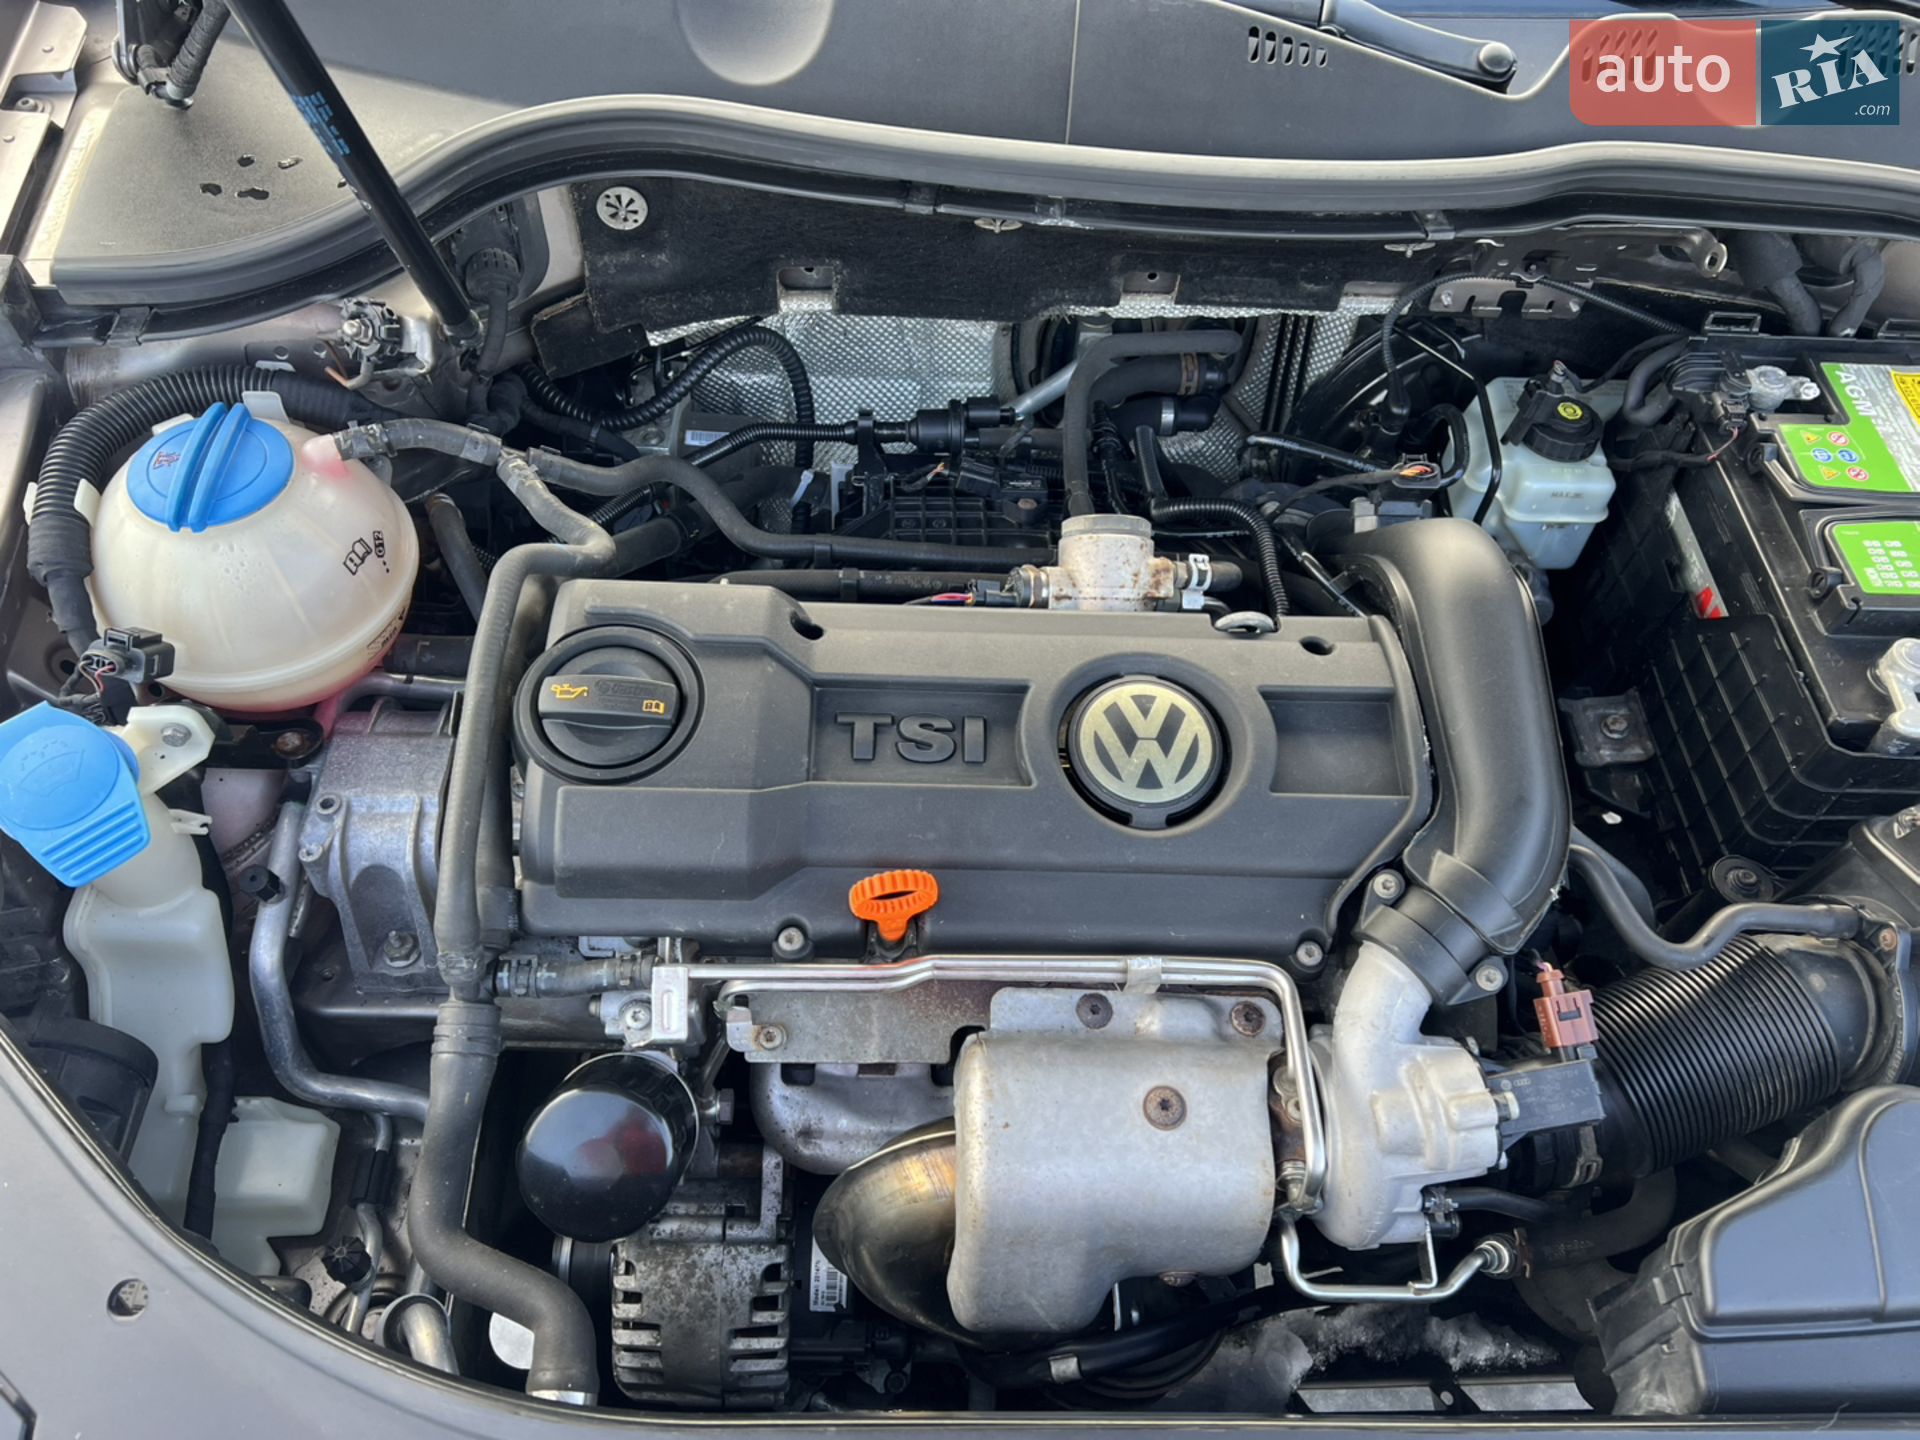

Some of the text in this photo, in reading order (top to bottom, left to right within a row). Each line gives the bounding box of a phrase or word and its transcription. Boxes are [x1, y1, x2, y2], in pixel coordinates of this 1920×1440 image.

[1835, 370, 1876, 417] AGM
[836, 711, 987, 764] TSI
[1079, 685, 1211, 802] VW
